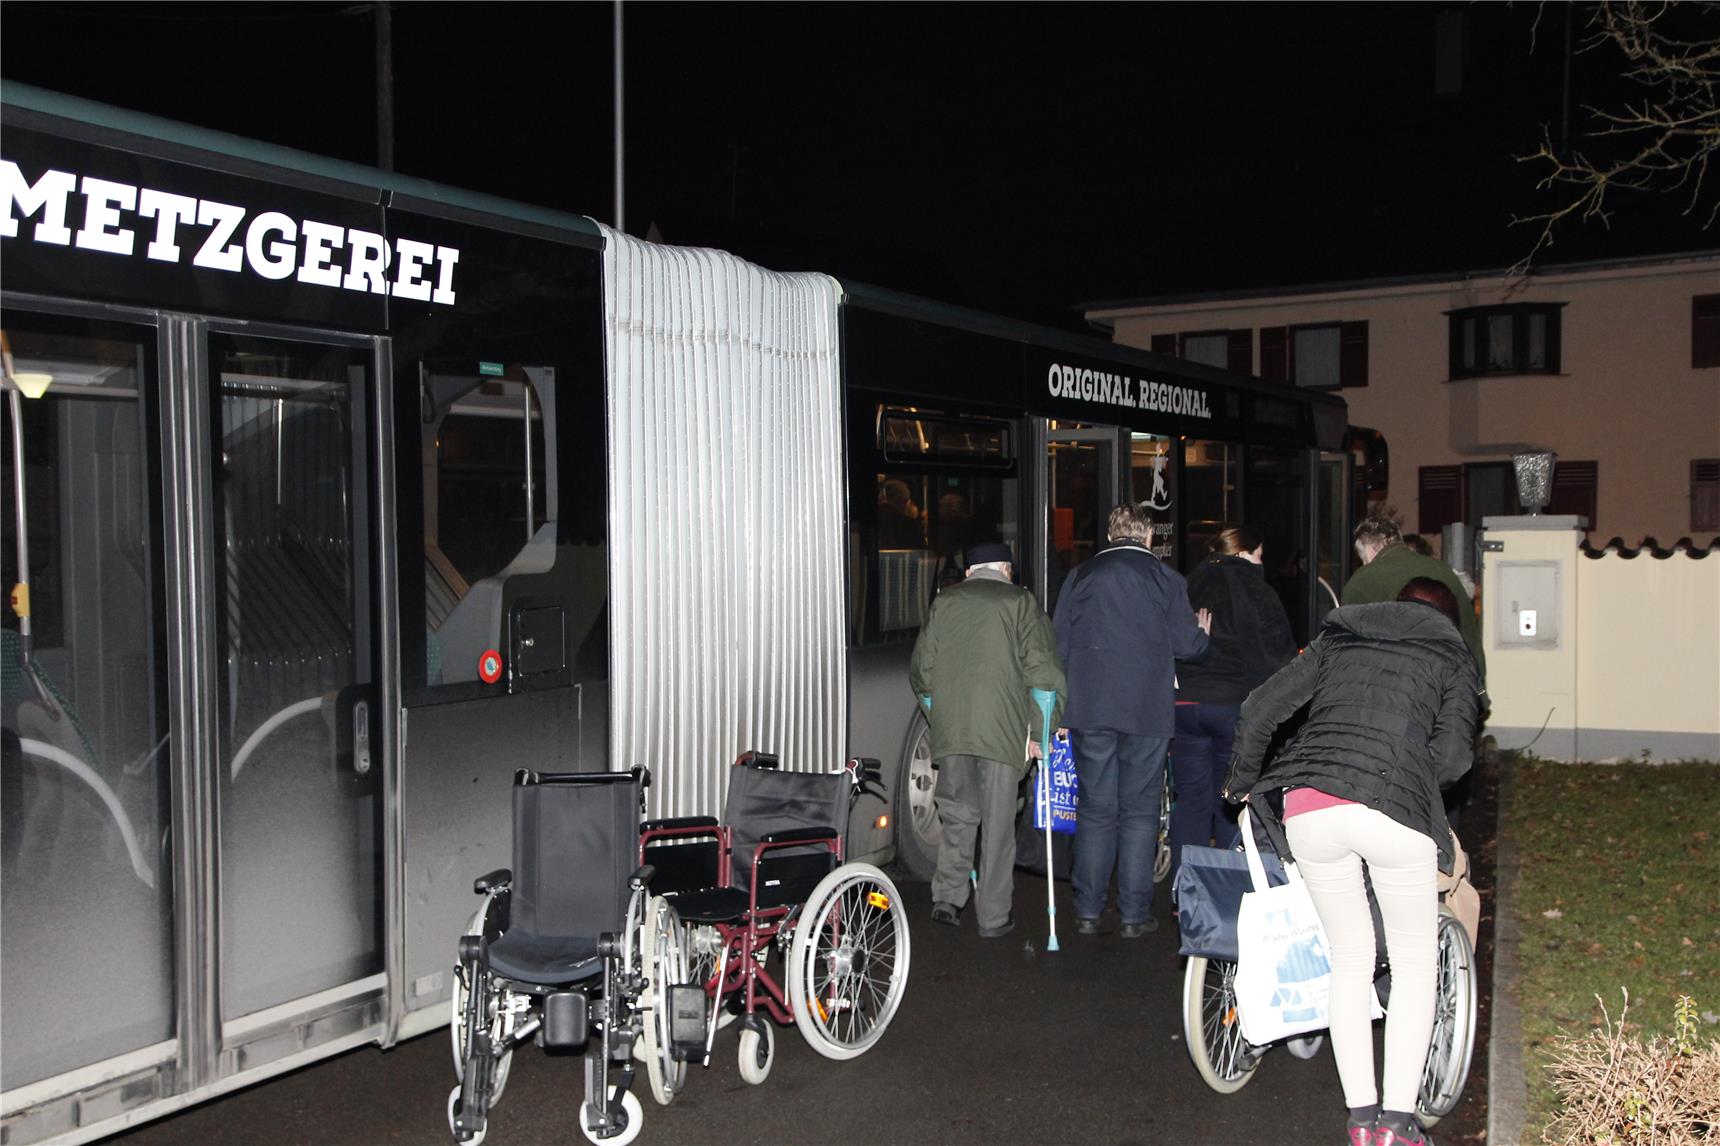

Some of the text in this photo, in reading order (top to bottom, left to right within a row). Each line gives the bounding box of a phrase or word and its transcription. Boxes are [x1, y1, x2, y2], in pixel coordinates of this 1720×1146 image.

[0, 159, 459, 305] METZGEREI
[1048, 363, 1212, 419] ORIGINAL. REGIONAL.
